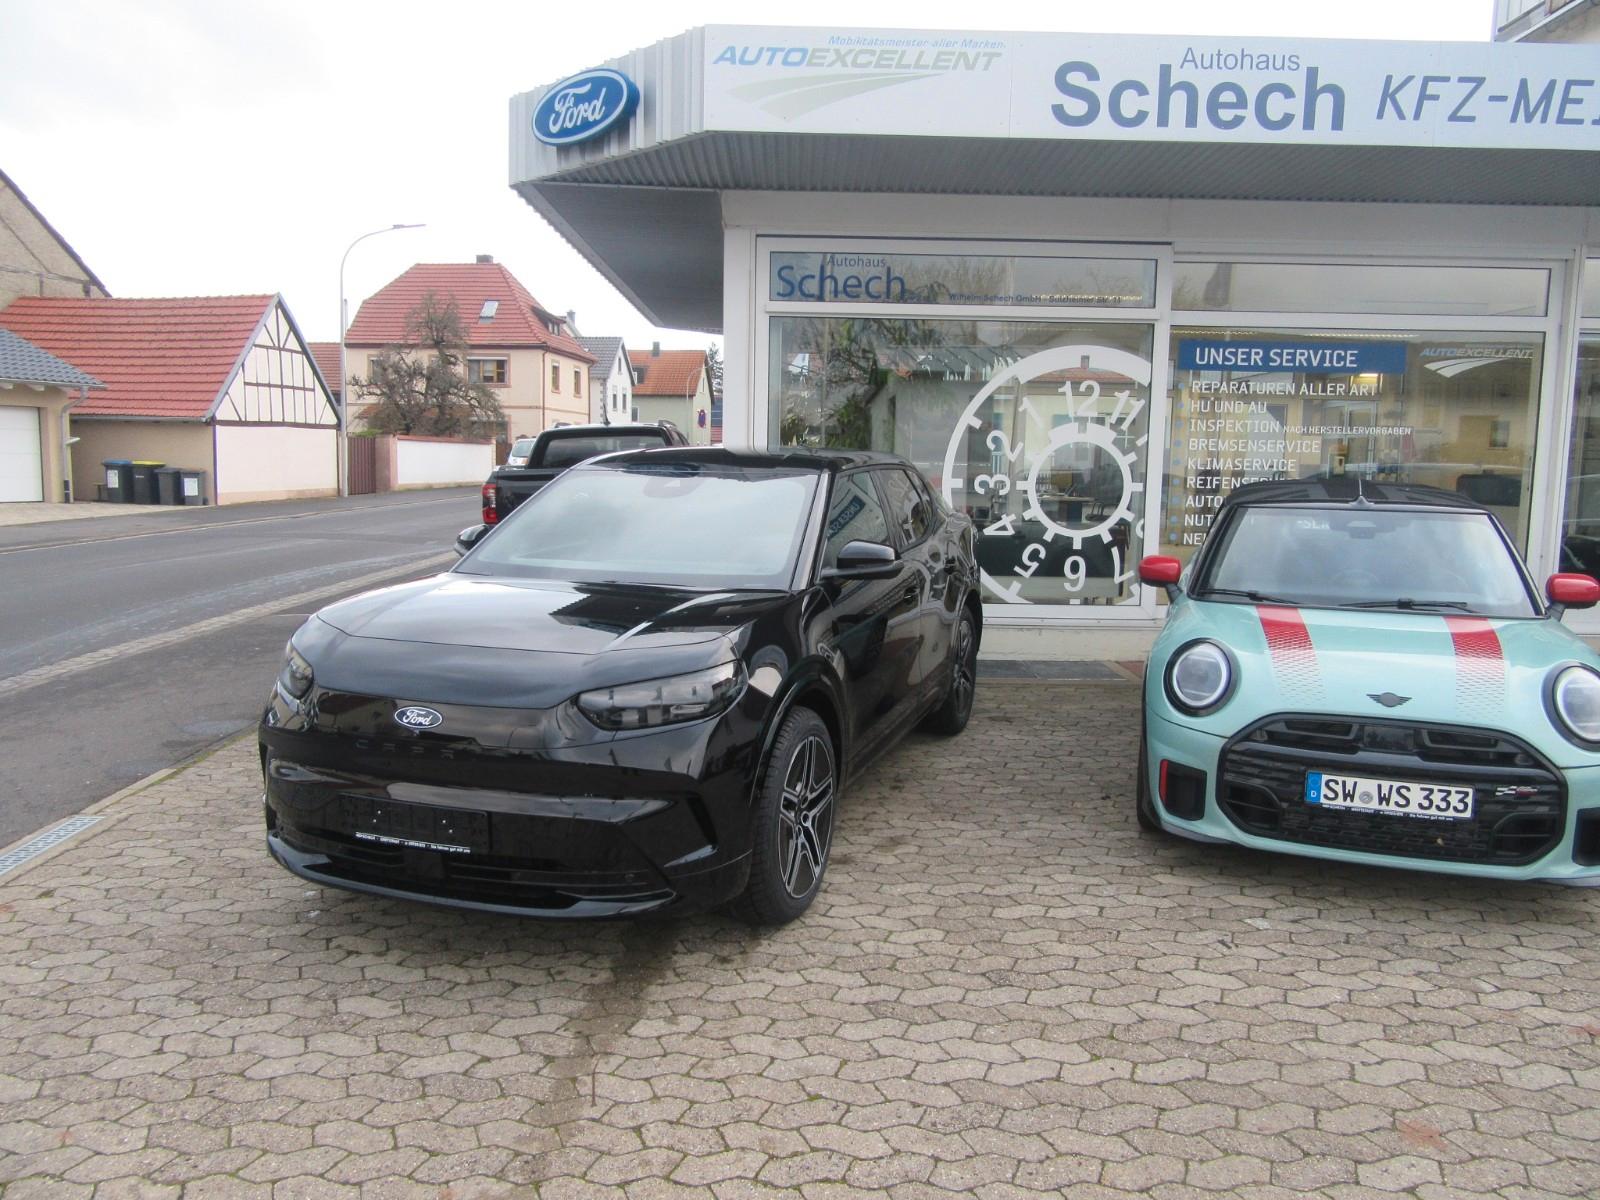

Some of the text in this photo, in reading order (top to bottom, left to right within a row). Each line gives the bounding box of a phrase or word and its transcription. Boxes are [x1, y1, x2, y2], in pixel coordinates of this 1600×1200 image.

[712, 45, 1003, 72] AUTOEXCELLENT
[1179, 47, 1301, 72] Autohaus
[1050, 60, 1346, 131] Schech
[1376, 74, 1600, 126] KFZ-ME
[548, 82, 607, 134] Ford
[826, 255, 888, 269] Autohaus
[776, 264, 906, 301] Schech
[1195, 346, 1360, 369] UNSER SERVICE
[1419, 347, 1536, 359] AUTOEXCELLENT
[1057, 380, 1101, 418] 12
[1192, 380, 1379, 397] REPARATUREN ALLER ART
[1214, 400, 1243, 414] UND
[1247, 401, 1268, 414] AU
[1189, 419, 1412, 436] INSPEKTION NACH HERSTELLERVORGABEN
[985, 429, 1024, 463] 2
[1188, 438, 1322, 453] BREMSENSERVICE
[1187, 457, 1297, 472] KLIMASERVICE
[974, 474, 1011, 496] 3
[1185, 495, 1226, 508] AUTO
[983, 513, 1017, 536] 4
[1013, 542, 1047, 579] 5
[402, 708, 434, 726] Ford
[1322, 778, 1358, 803] SW
[1376, 783, 1412, 809] WS
[1417, 787, 1470, 814] 333
